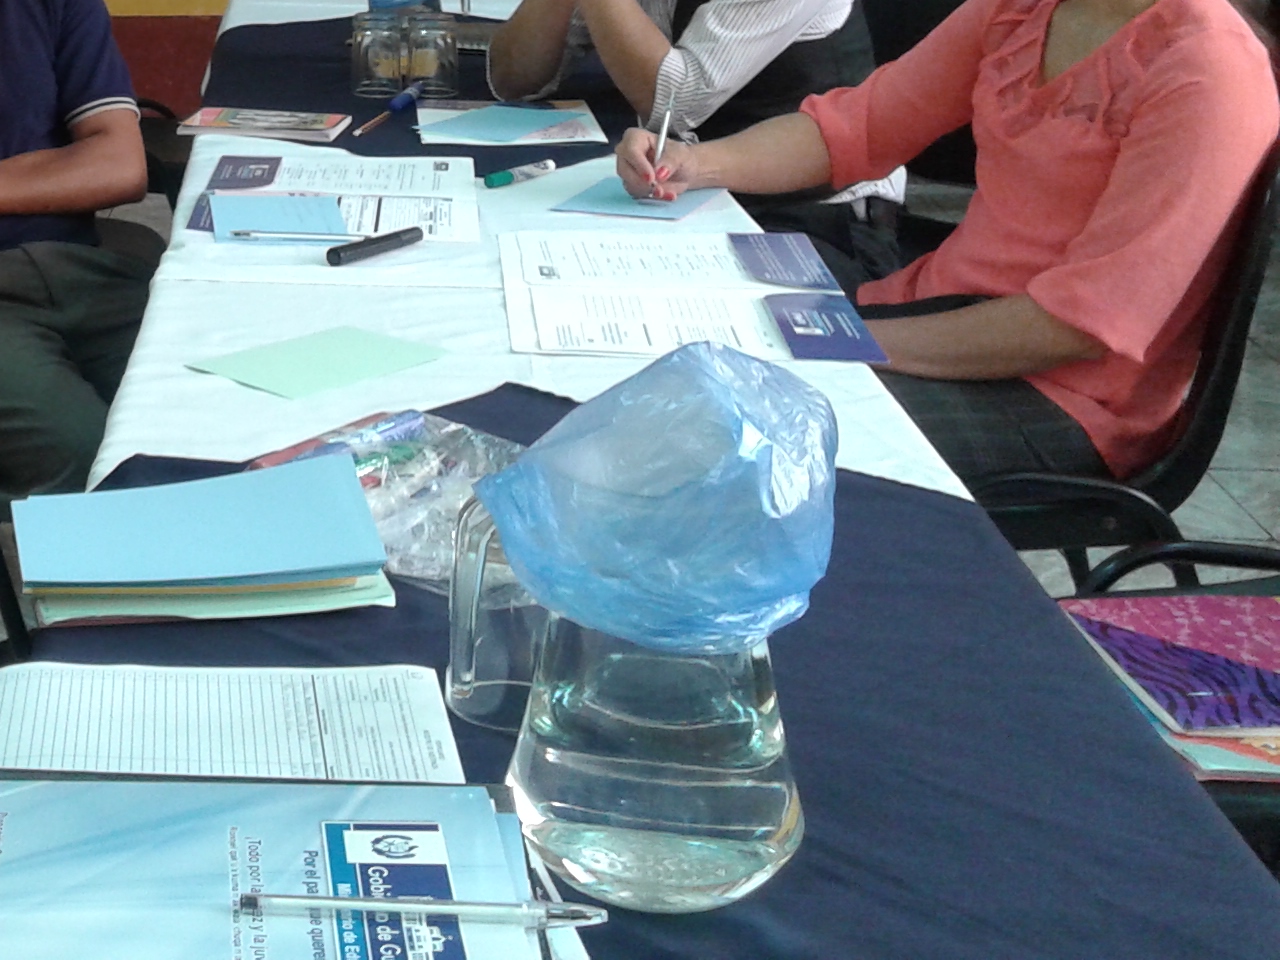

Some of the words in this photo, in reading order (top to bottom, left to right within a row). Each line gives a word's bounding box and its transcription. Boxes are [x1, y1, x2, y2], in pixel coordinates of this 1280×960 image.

[303, 850, 319, 868] Por
[246, 865, 262, 882] por
[305, 869, 320, 879] el
[250, 884, 265, 894] la
[254, 934, 268, 944] la
[376, 926, 400, 942] de
